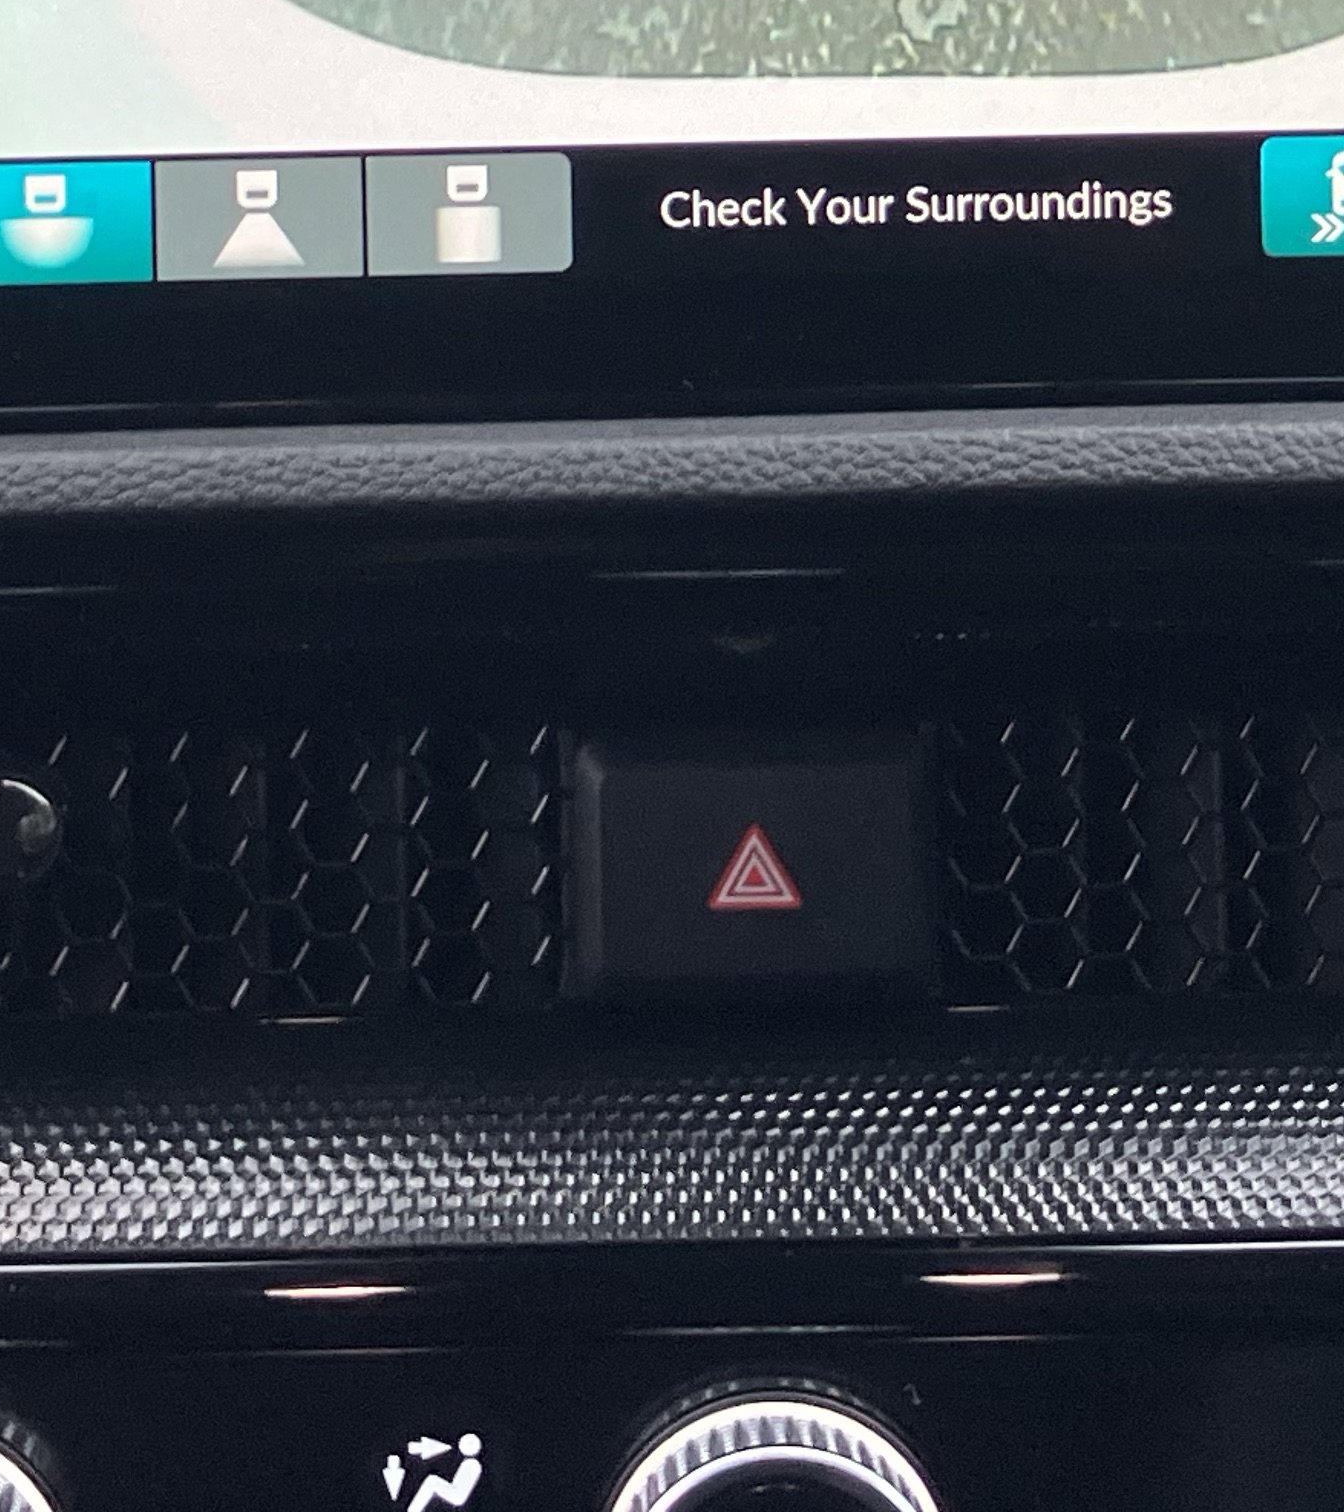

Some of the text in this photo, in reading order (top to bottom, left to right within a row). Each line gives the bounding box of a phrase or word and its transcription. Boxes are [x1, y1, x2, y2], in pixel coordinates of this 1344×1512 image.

[660, 180, 1174, 229] Check Your Surroundings
